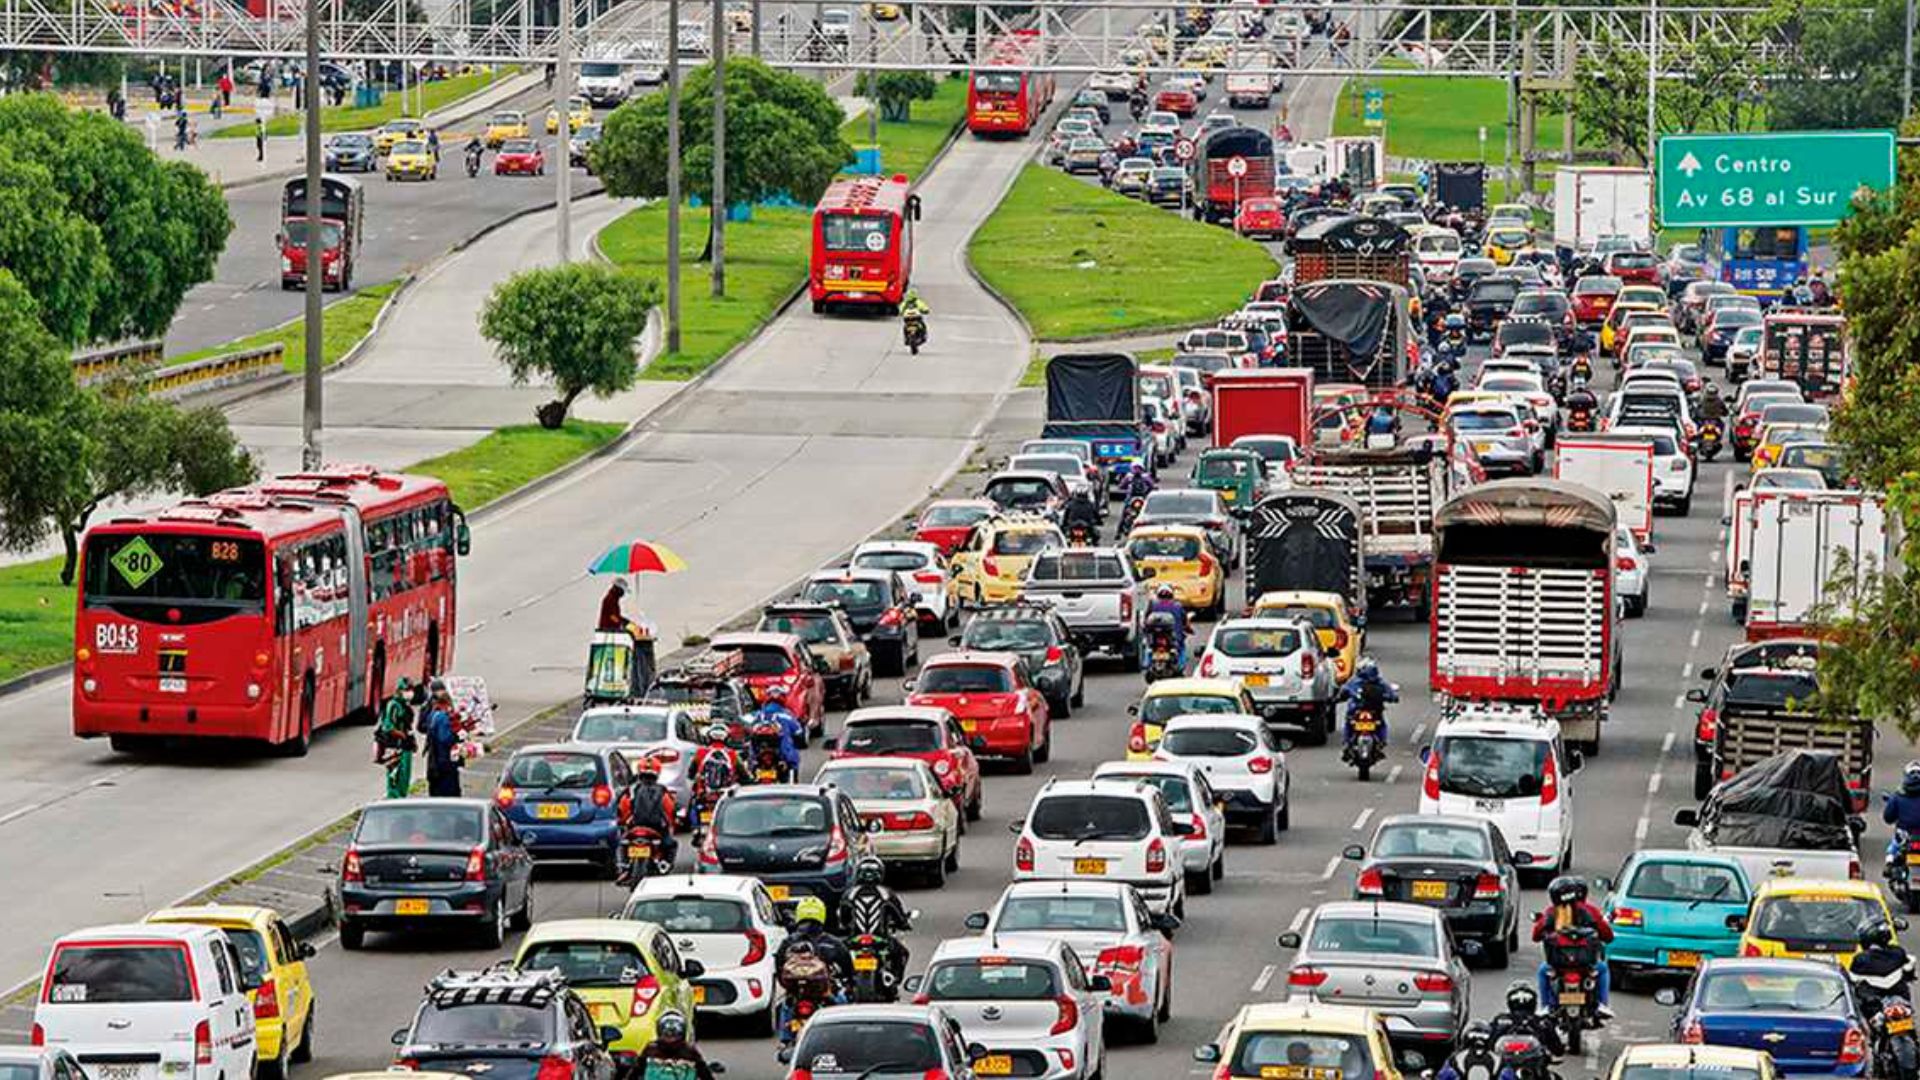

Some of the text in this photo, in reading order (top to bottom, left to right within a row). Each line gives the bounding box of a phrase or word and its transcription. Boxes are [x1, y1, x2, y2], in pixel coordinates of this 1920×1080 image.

[1715, 154, 1791, 173] Centro
[1676, 187, 1837, 208] Av 68 al Sur
[127, 551, 152, 573] 80
[96, 623, 139, 649] B043
